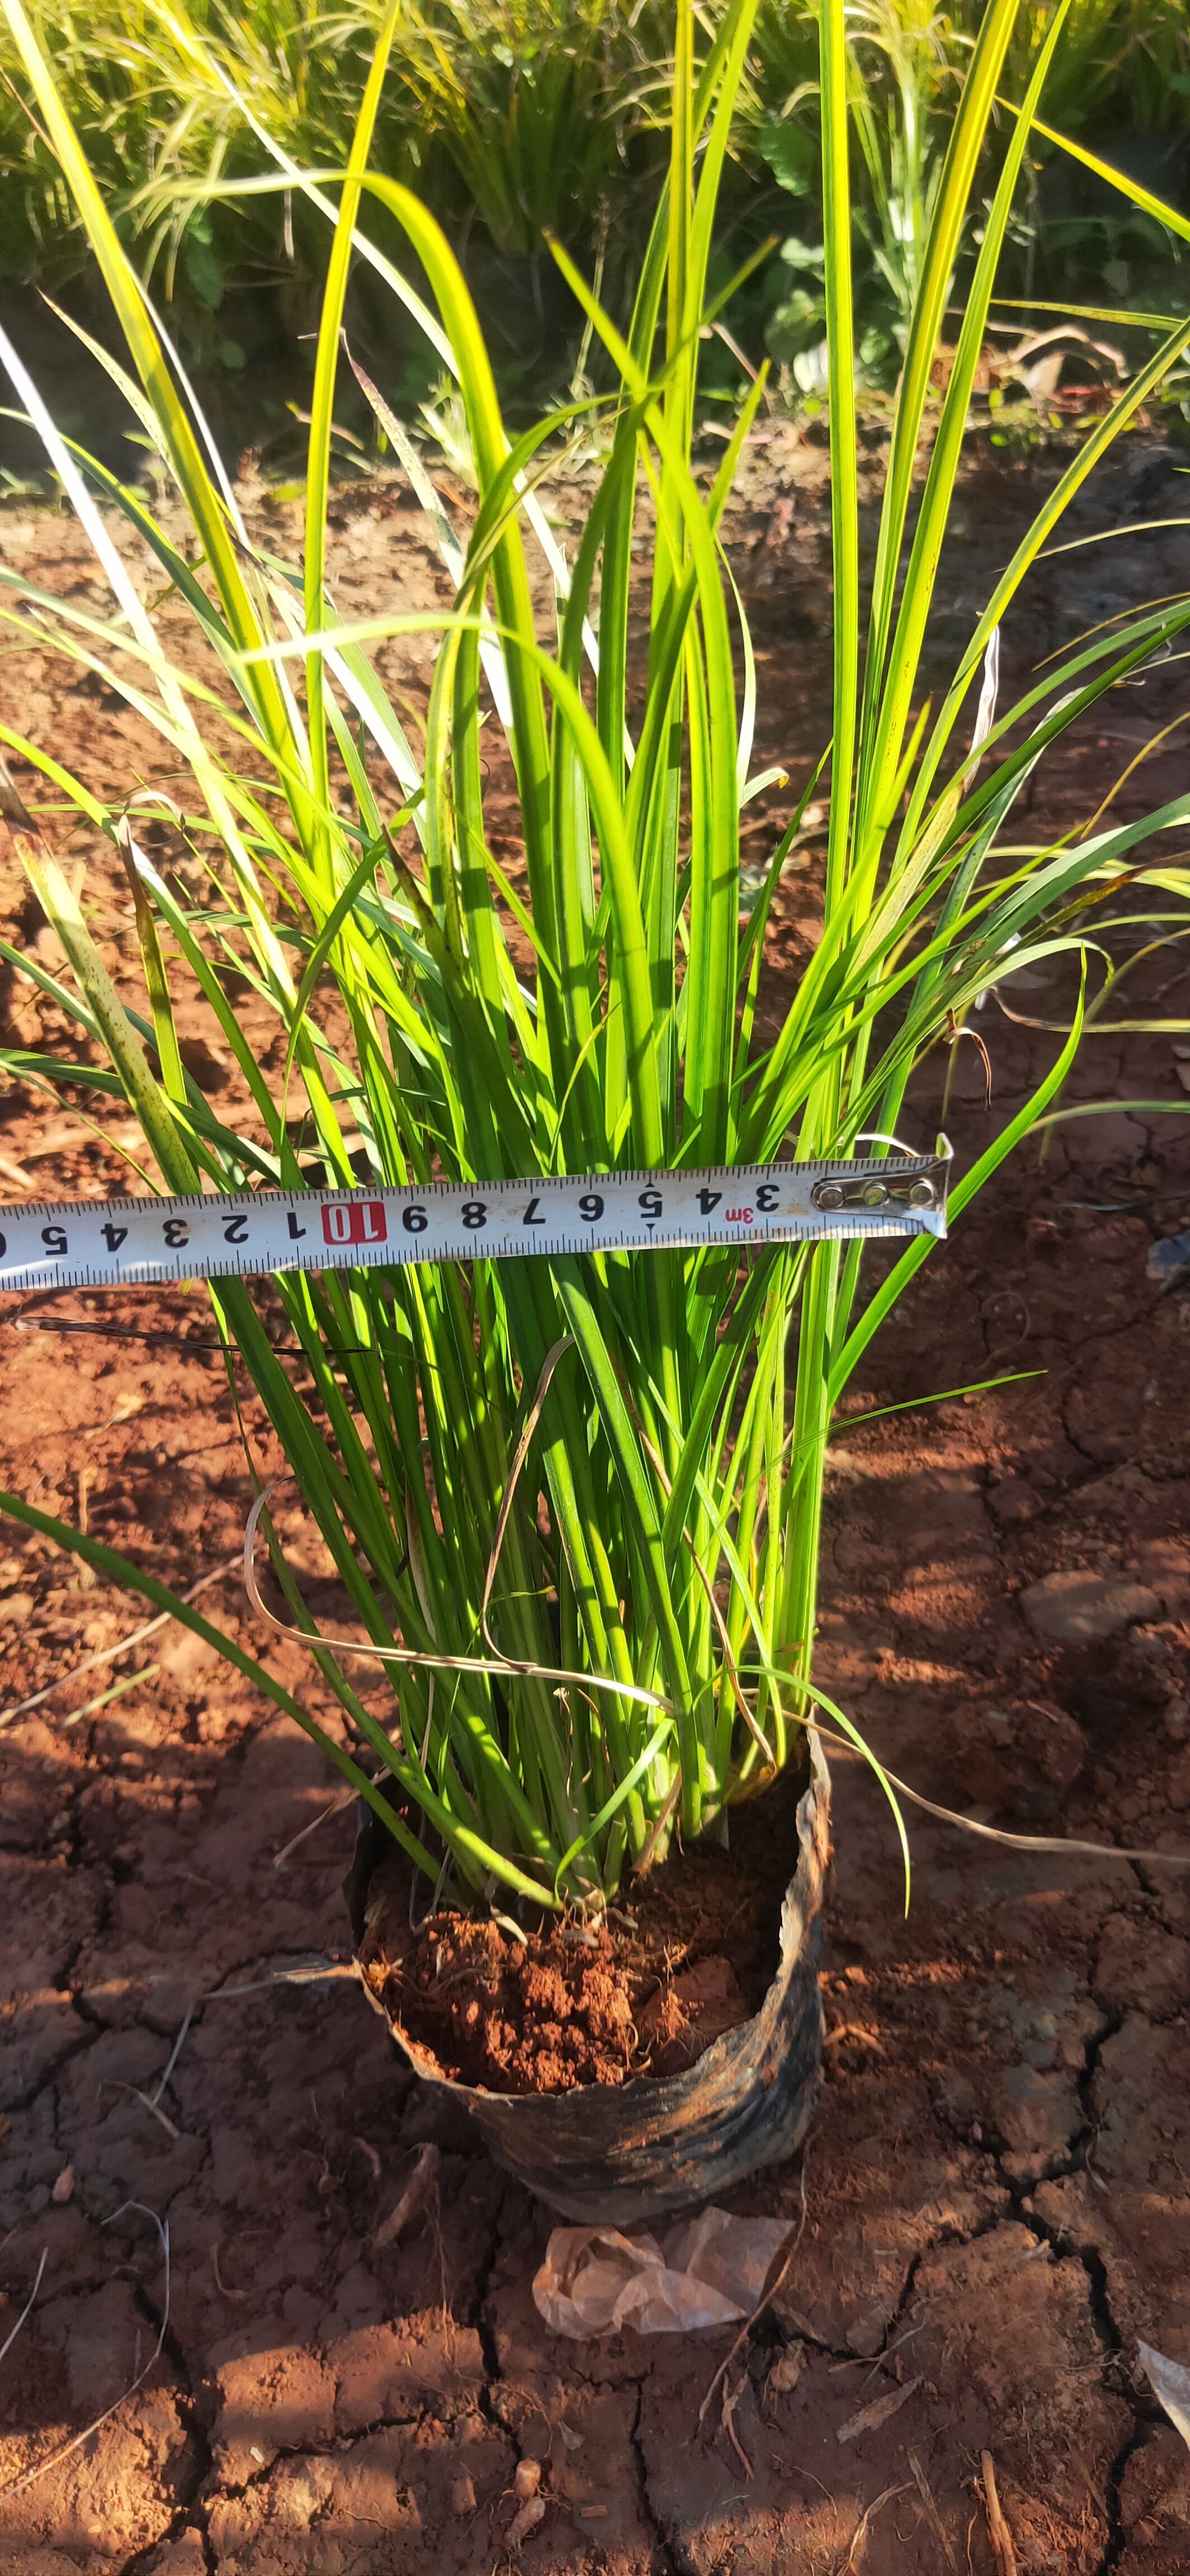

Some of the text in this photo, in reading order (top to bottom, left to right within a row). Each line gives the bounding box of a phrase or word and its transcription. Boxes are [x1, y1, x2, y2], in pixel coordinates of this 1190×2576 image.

[41, 1184, 780, 1256] 3 4 5 6 7 8 9 10 1 2 3 4 5
[725, 1208, 753, 1224] 3m
